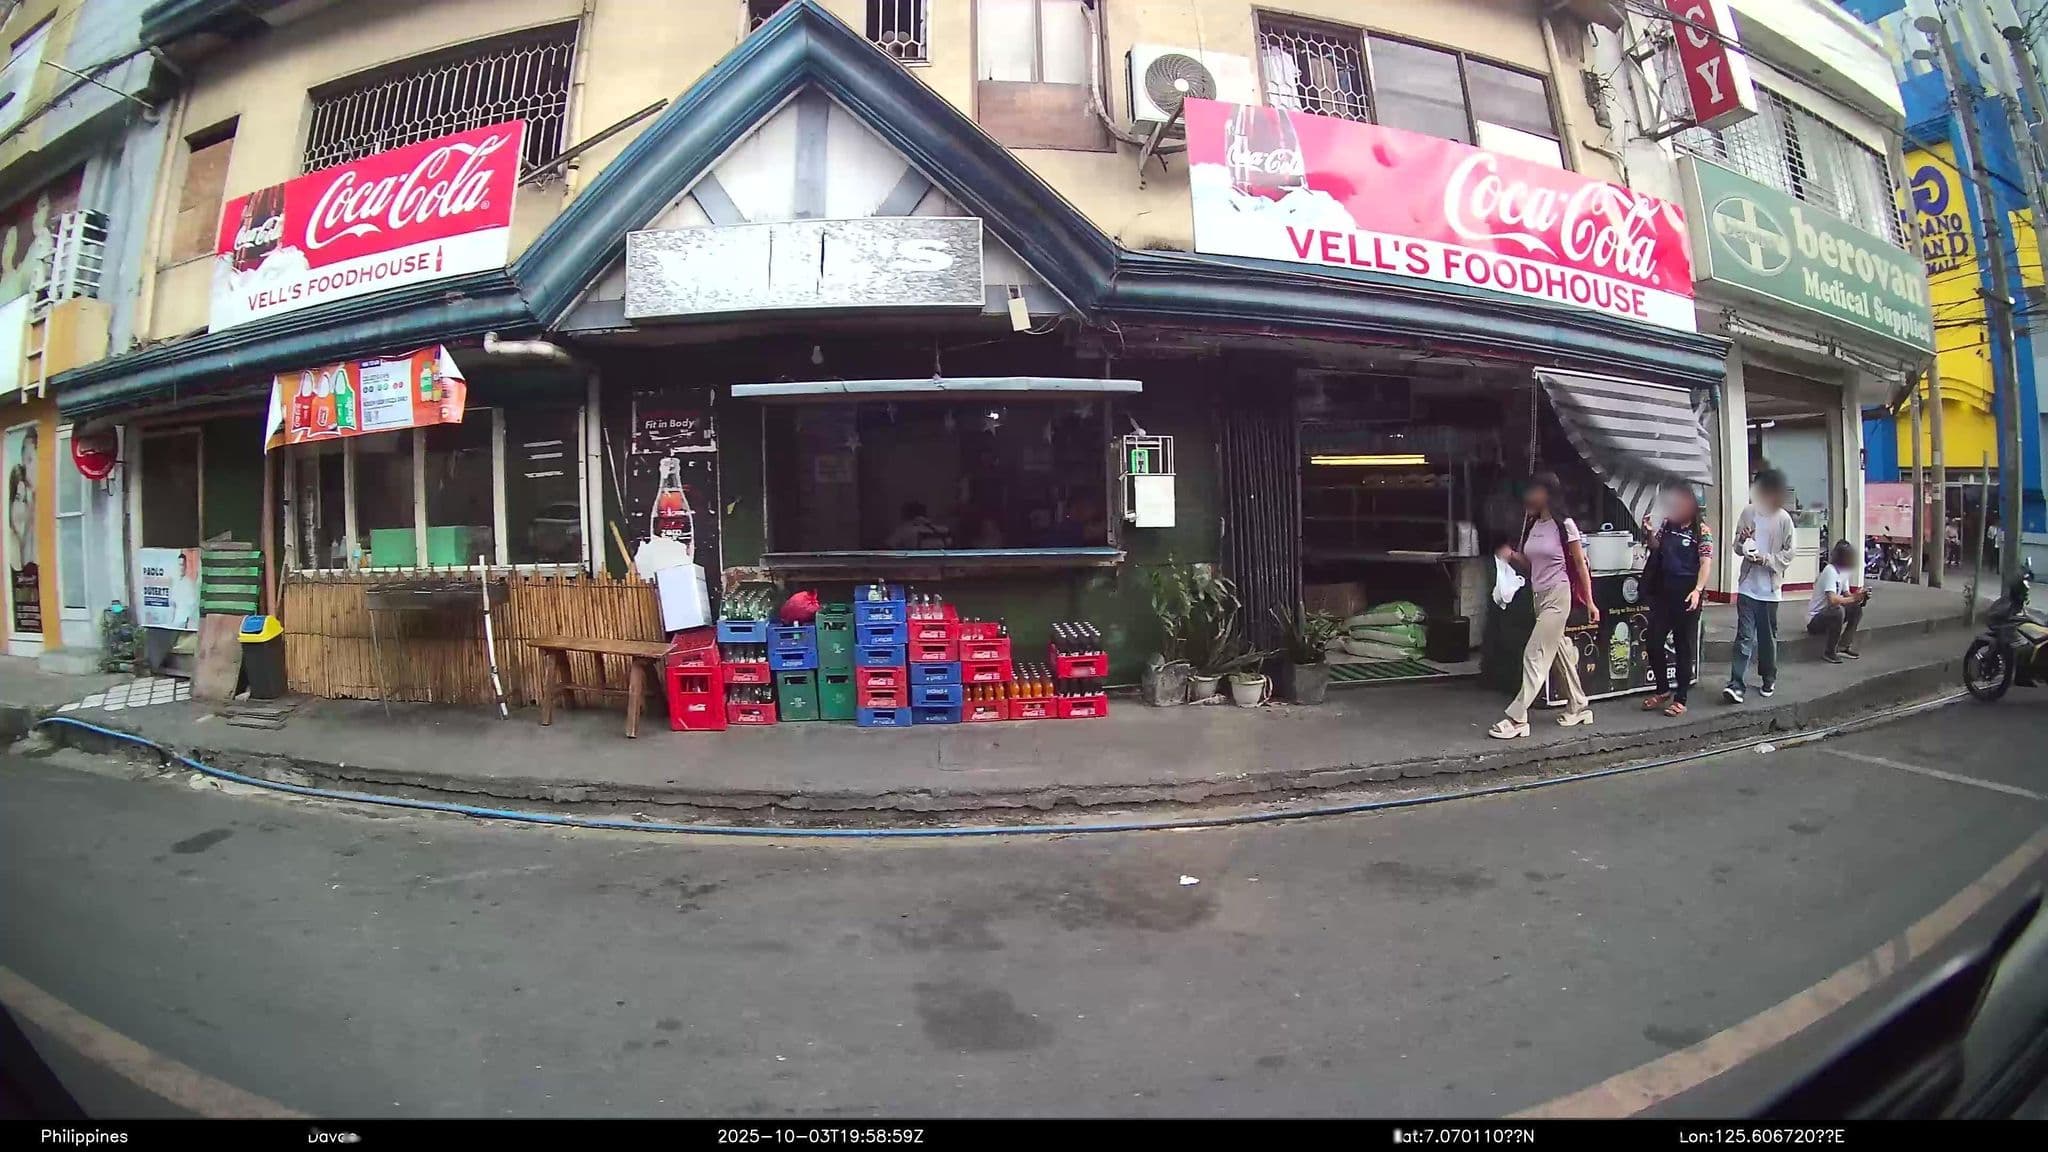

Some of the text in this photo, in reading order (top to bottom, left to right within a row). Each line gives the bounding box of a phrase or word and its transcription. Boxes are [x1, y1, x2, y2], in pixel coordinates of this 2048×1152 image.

[305, 131, 512, 250] Coca-Cola
[1443, 152, 1662, 280] Coca-Cola
[248, 252, 430, 312] VELL'S FOODHOUSE
[1285, 226, 1649, 318] VELL'S FOODHOUSE
[1790, 206, 1925, 308] berovan
[1802, 267, 1871, 319] Medical
[645, 418, 695, 429] Fit in Body
